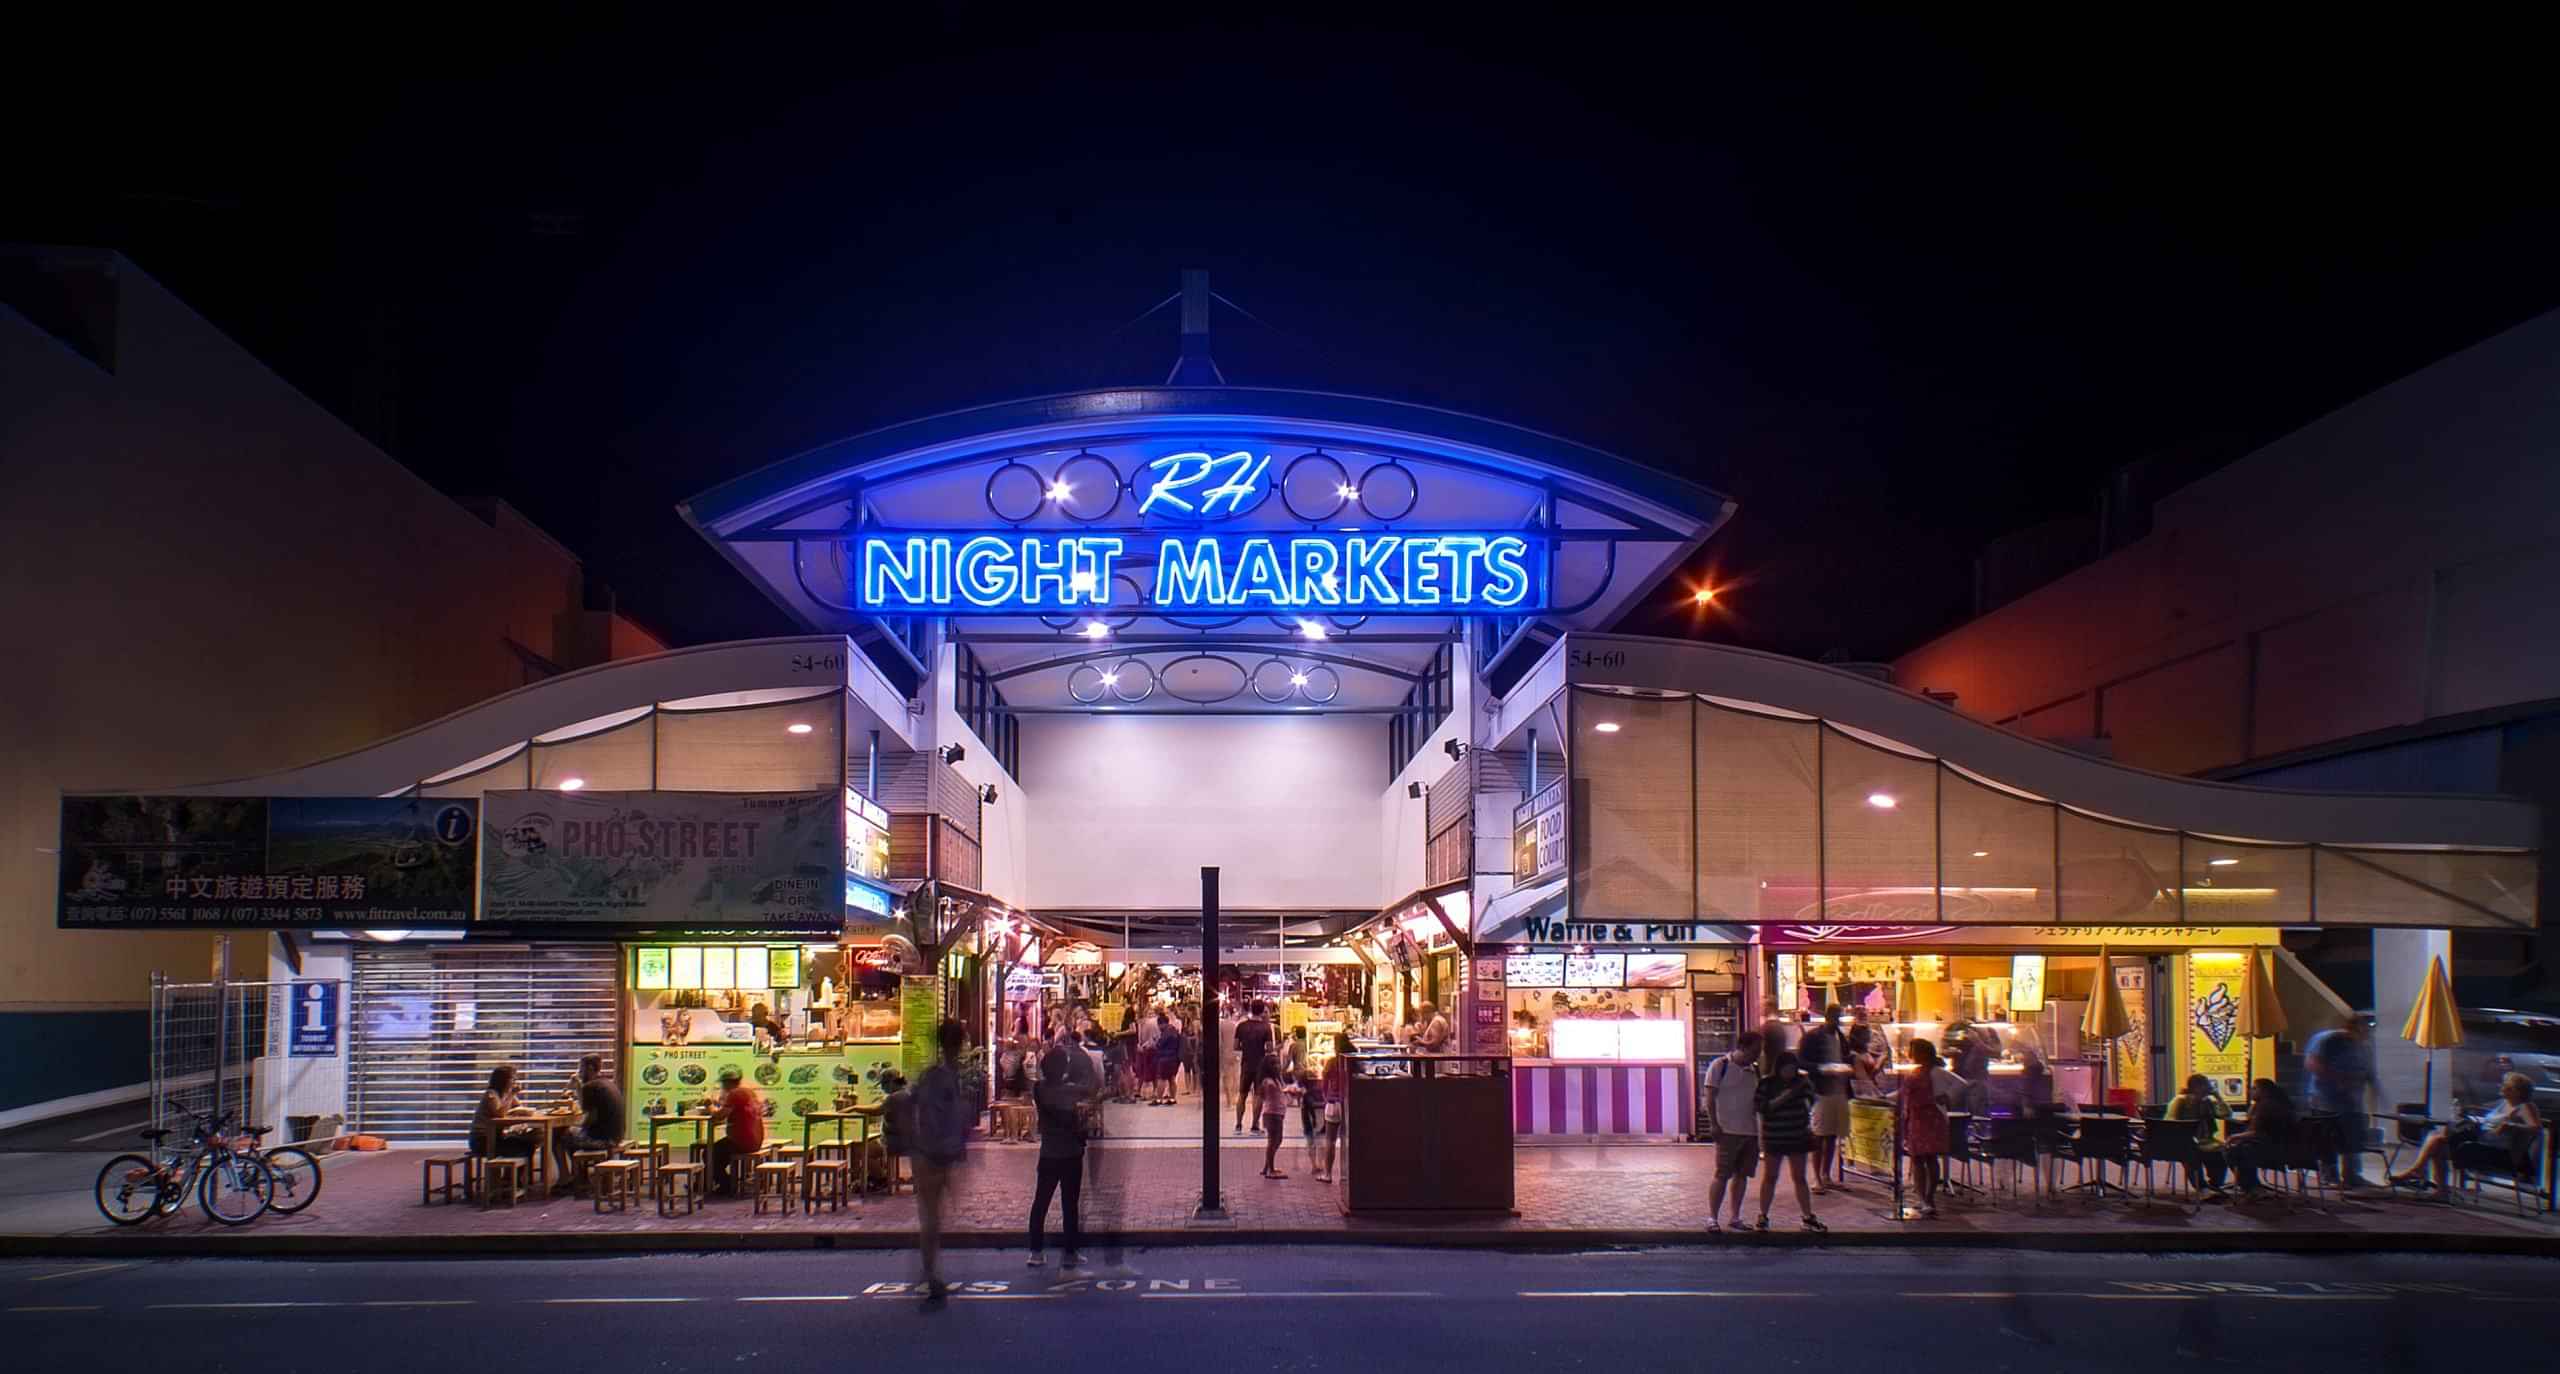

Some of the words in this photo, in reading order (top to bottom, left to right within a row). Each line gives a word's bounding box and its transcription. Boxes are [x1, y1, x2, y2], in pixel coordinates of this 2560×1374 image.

[1138, 451, 1272, 515] RH
[864, 537, 1123, 606] NIGHT
[1155, 537, 1530, 607] MARKETS
[792, 655, 845, 672] 54-60
[1569, 650, 1625, 668] 54-60
[1540, 811, 1562, 842] FOOD
[638, 821, 761, 858] STREET
[1539, 838, 1565, 868] COURT
[165, 874, 366, 900] 中文旅遊預定服務
[776, 879, 803, 890] DINE
[807, 879, 819, 889] IN
[130, 905, 158, 922] (07)
[231, 905, 258, 922] (07)
[763, 912, 794, 921] TAKE
[800, 912, 832, 921] AWAY
[1525, 917, 1607, 942] Waffle
[1613, 923, 1632, 942] &
[1646, 924, 1698, 942] Puff
[680, 1050, 706, 1060] STREET
[863, 1280, 1011, 1295] BUS
[1046, 1278, 1242, 1292] ZONE
